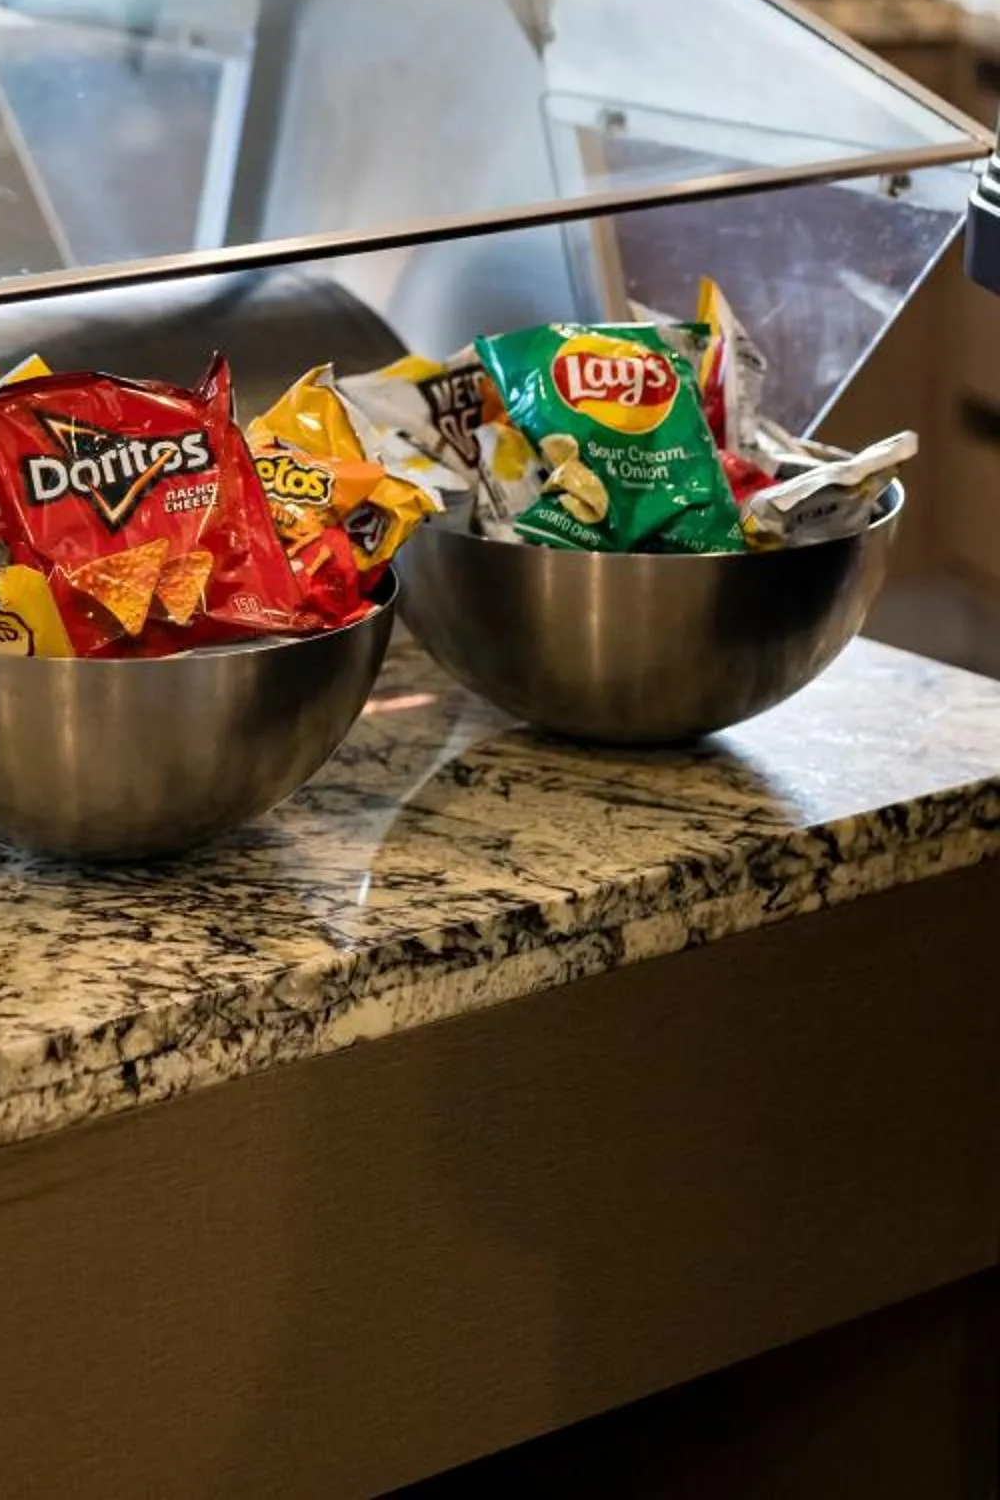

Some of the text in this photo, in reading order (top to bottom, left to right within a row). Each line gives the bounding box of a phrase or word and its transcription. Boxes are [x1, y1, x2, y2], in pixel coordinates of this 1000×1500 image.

[565, 353, 668, 407] Lay's
[586, 440, 685, 463] Sour Cream
[29, 433, 209, 500] Doritos
[255, 455, 327, 498] etos
[618, 462, 670, 480] Onion
[165, 482, 218, 501] NACHO
[164, 494, 218, 513] CHEESE
